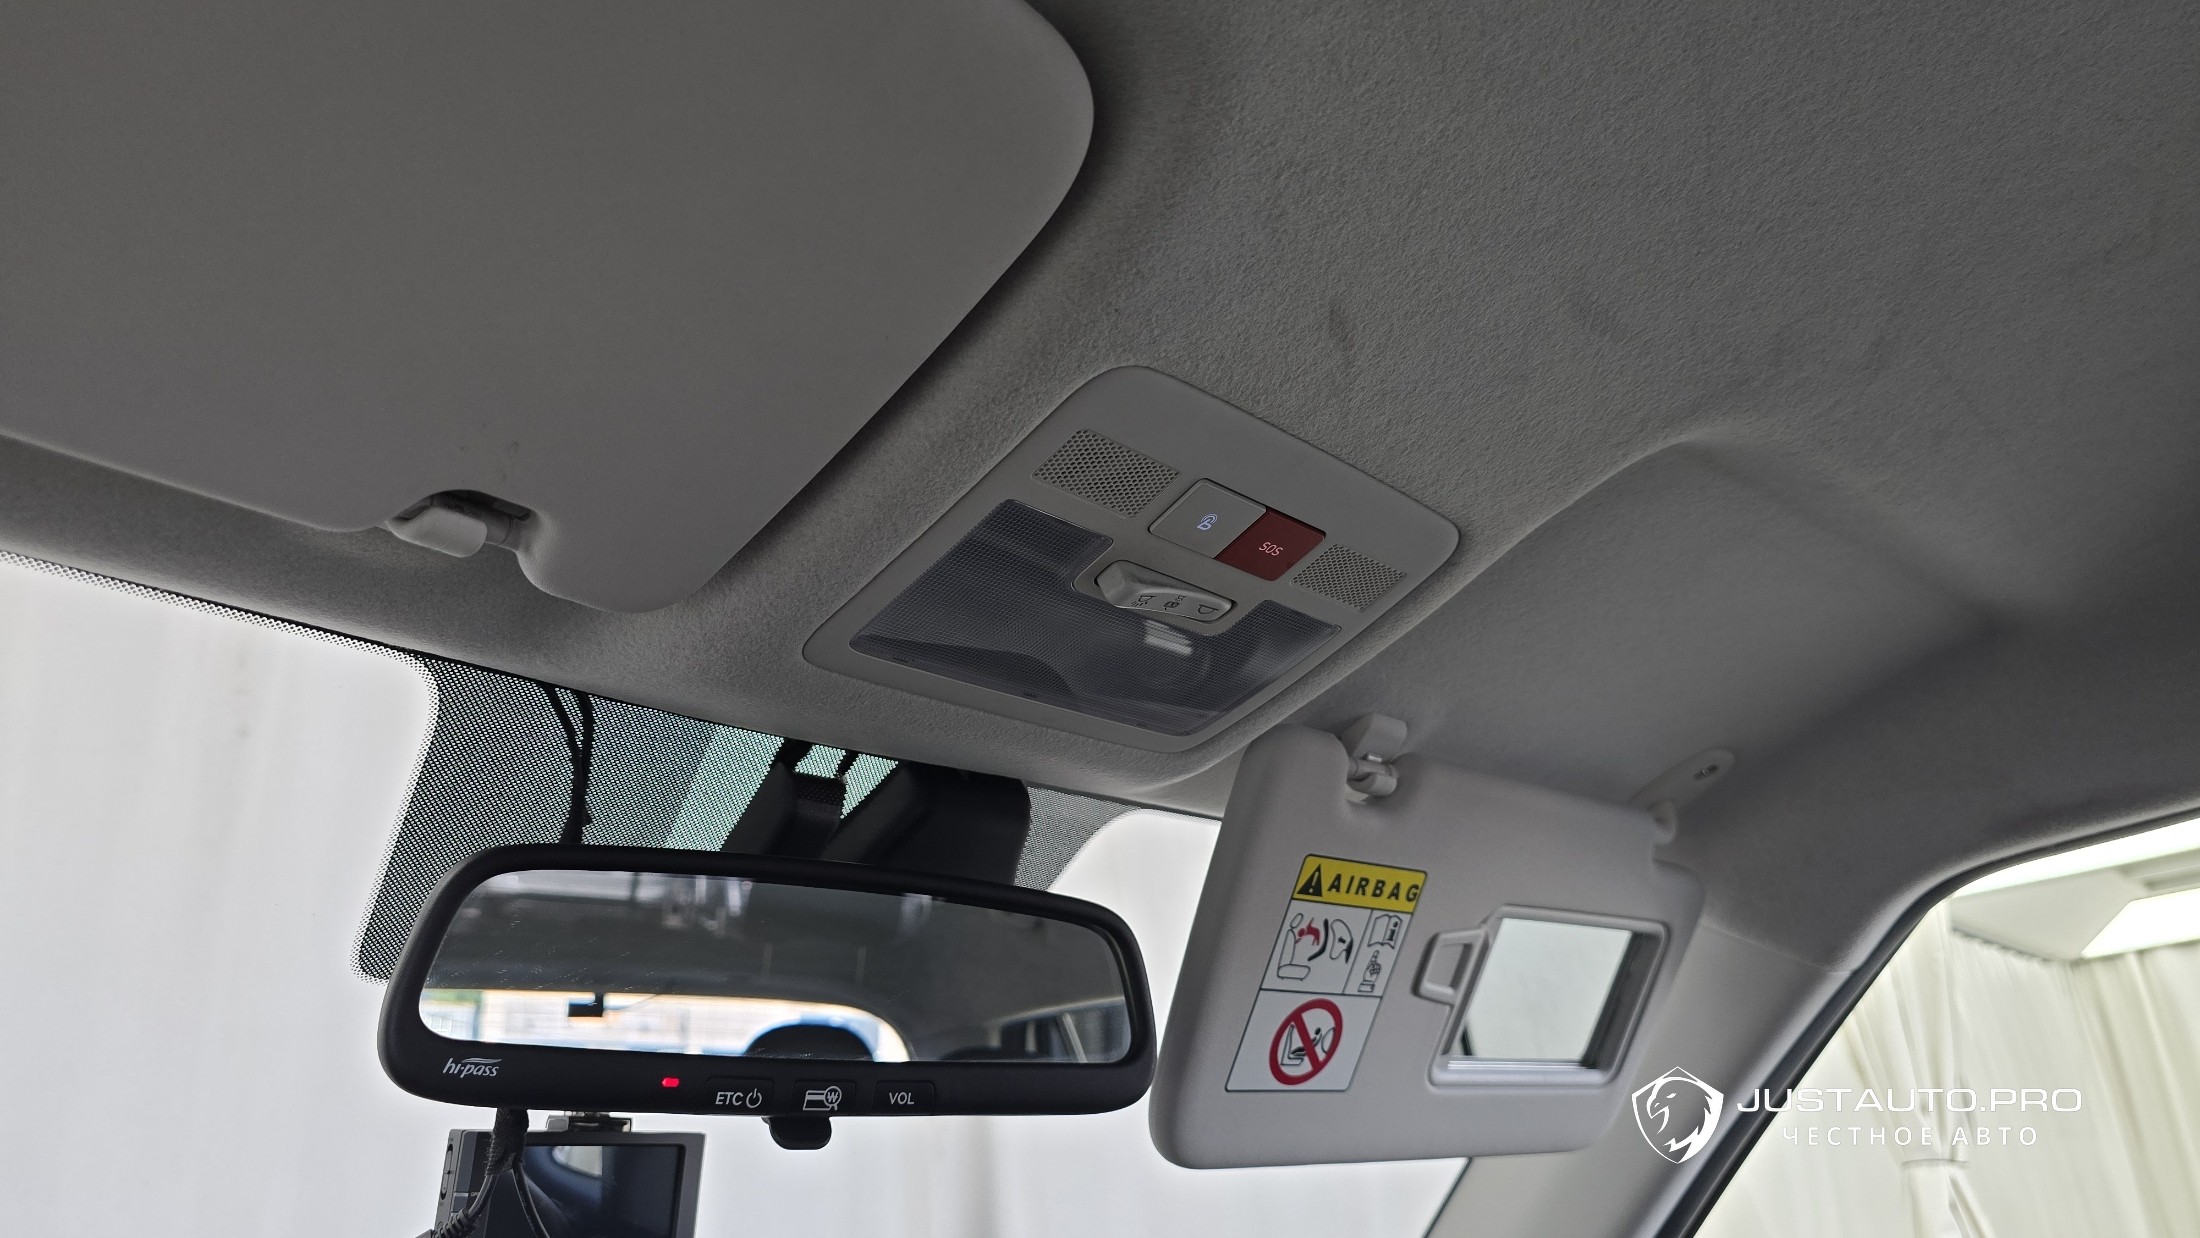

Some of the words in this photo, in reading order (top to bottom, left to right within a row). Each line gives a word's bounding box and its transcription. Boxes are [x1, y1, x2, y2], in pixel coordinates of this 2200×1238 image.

[1258, 541, 1284, 556] SOS
[1327, 873, 1420, 902] AIRBAG
[443, 1057, 499, 1078] hi-pass
[715, 1091, 744, 1106] ETC
[888, 1092, 915, 1105] VOL
